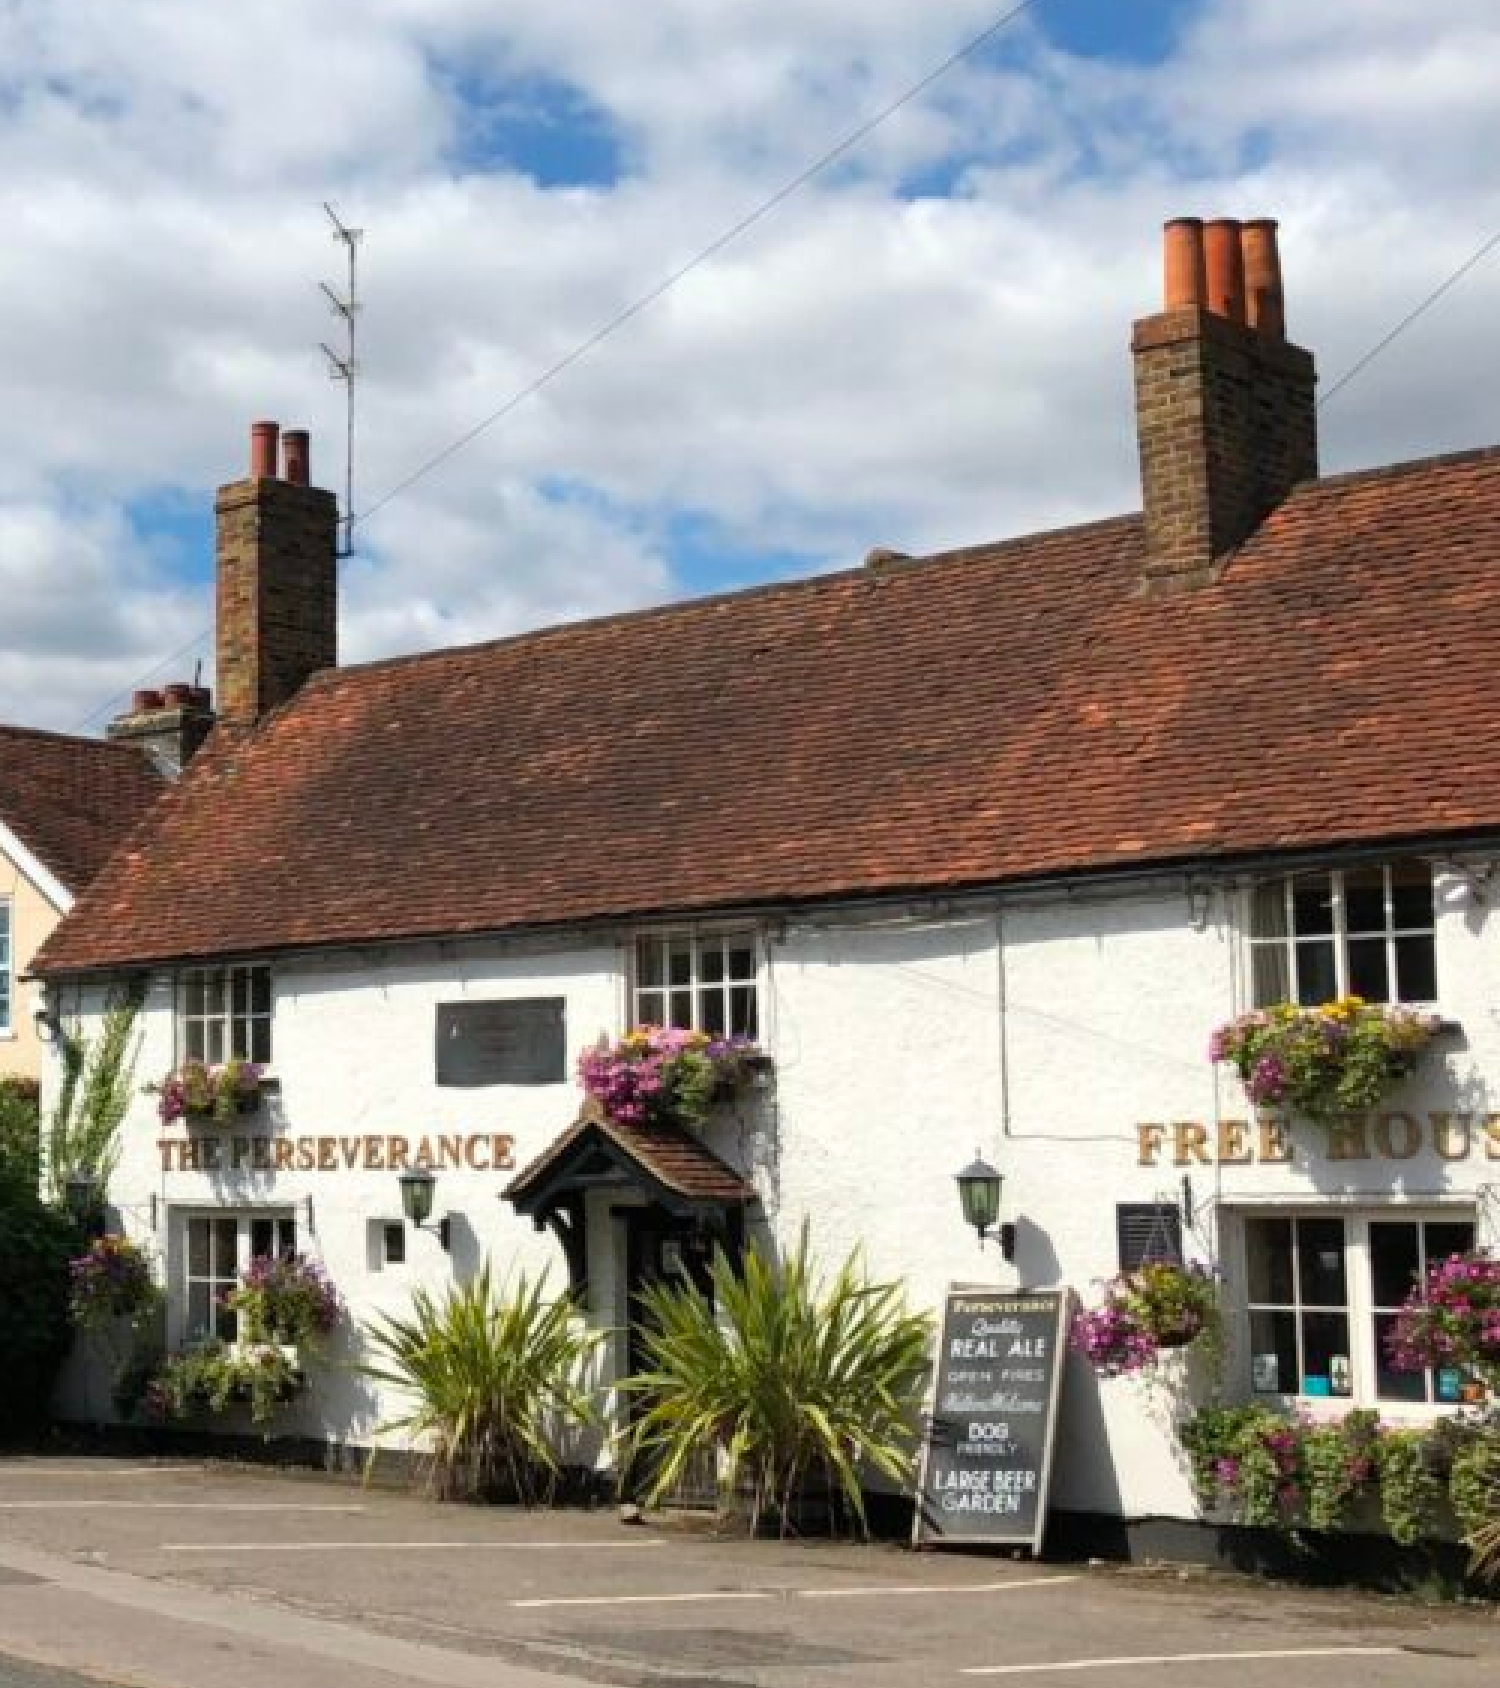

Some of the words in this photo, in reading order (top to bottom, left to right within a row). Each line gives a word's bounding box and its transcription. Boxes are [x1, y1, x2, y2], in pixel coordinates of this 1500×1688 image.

[156, 1136, 218, 1172] THE
[231, 1133, 517, 1172] PERSEVERANCE
[1136, 1117, 1294, 1167] FREE
[950, 1338, 1000, 1359] REAL
[1007, 1337, 1046, 1358] ALE
[947, 1370, 992, 1383] OPEN
[1001, 1368, 1045, 1382] FIRES
[968, 1422, 1009, 1440] DOG
[956, 1440, 1019, 1454] FRIENDLY
[933, 1470, 991, 1490] LARGE
[993, 1470, 1037, 1492] BEER
[941, 1491, 1022, 1514] GARDEN
